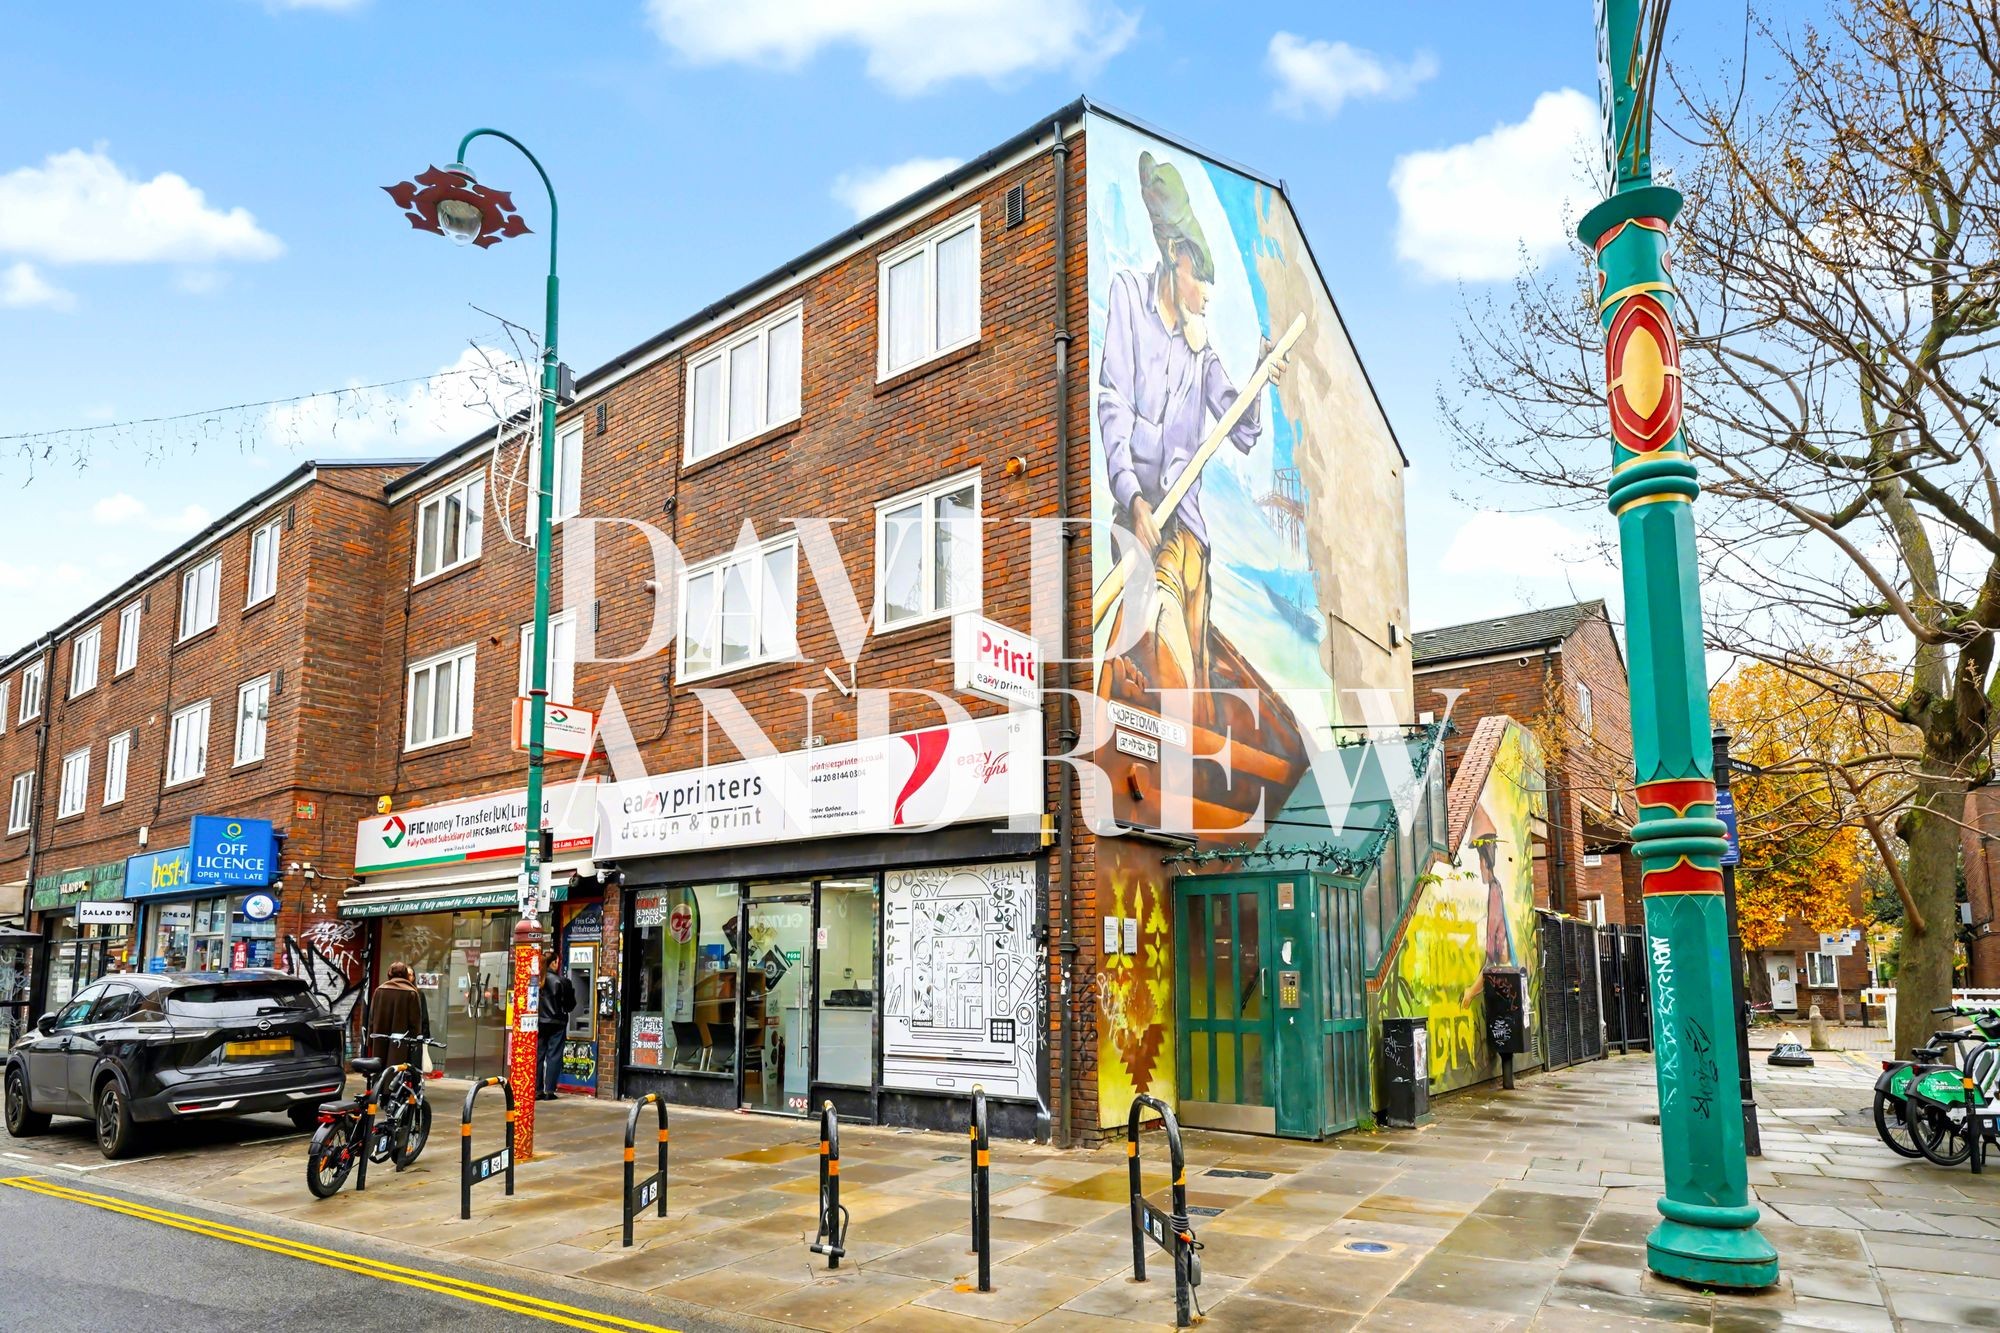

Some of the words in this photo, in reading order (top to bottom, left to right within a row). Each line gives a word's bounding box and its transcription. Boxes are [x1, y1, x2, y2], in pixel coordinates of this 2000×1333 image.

[977, 630, 1034, 681] Print
[1112, 707, 1159, 733] HOPETOWN
[956, 750, 992, 767] eazy
[973, 762, 1008, 784] Signs
[408, 821, 424, 836] IFIC
[426, 818, 453, 834] Money
[456, 809, 492, 828] Transfer
[621, 820, 679, 841] design
[689, 812, 699, 831] &
[710, 806, 762, 835] print
[407, 837, 420, 847] Fully
[465, 829, 472, 838] of
[217, 843, 247, 856] OFF
[197, 855, 264, 871] LICENCE
[197, 871, 219, 879] OPEN
